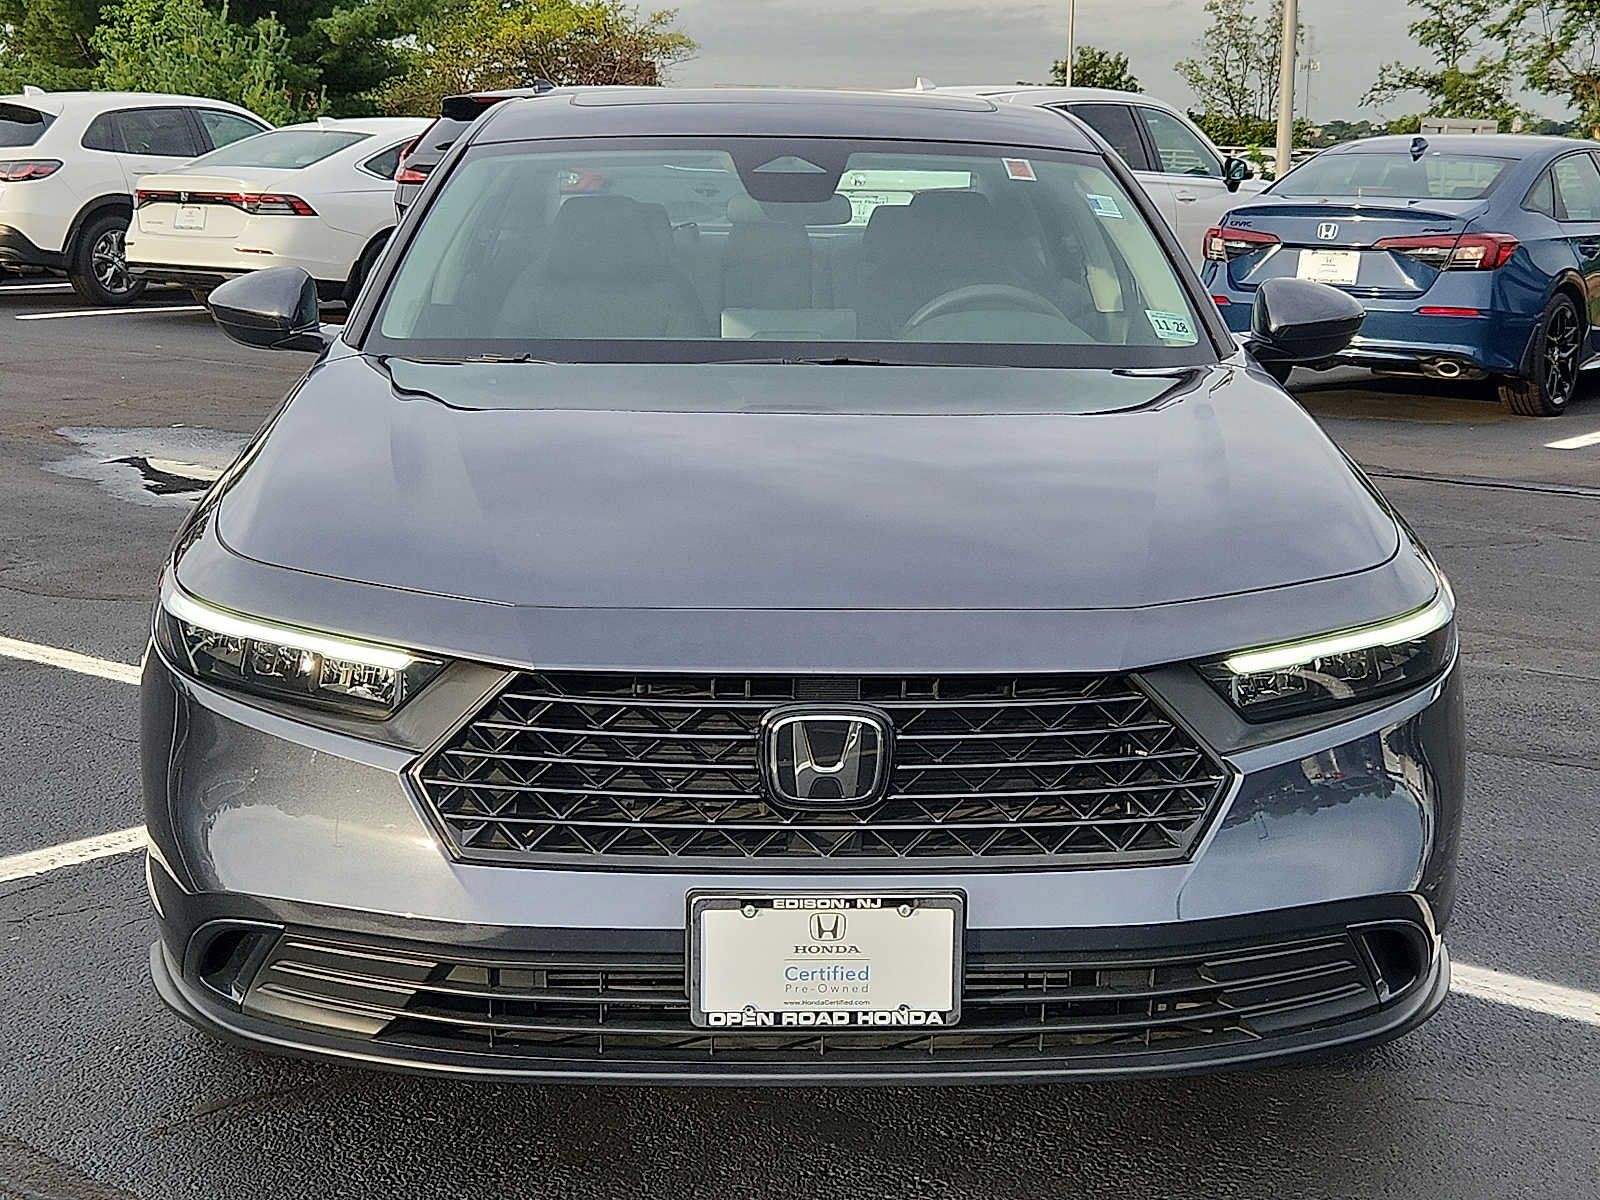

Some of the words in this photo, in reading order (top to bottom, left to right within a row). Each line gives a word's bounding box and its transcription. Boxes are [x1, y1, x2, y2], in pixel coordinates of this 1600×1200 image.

[1154, 319, 1171, 331] 11
[1172, 321, 1189, 334] 28
[772, 898, 850, 910] EDISON,
[856, 898, 882, 910] NJ
[792, 945, 861, 954] HONDA
[784, 965, 870, 981] Certified
[784, 983, 870, 994] Pre-Owned
[708, 1011, 775, 1026] OPEN
[781, 1011, 850, 1026] ROAD
[857, 1011, 944, 1026] HONDA
